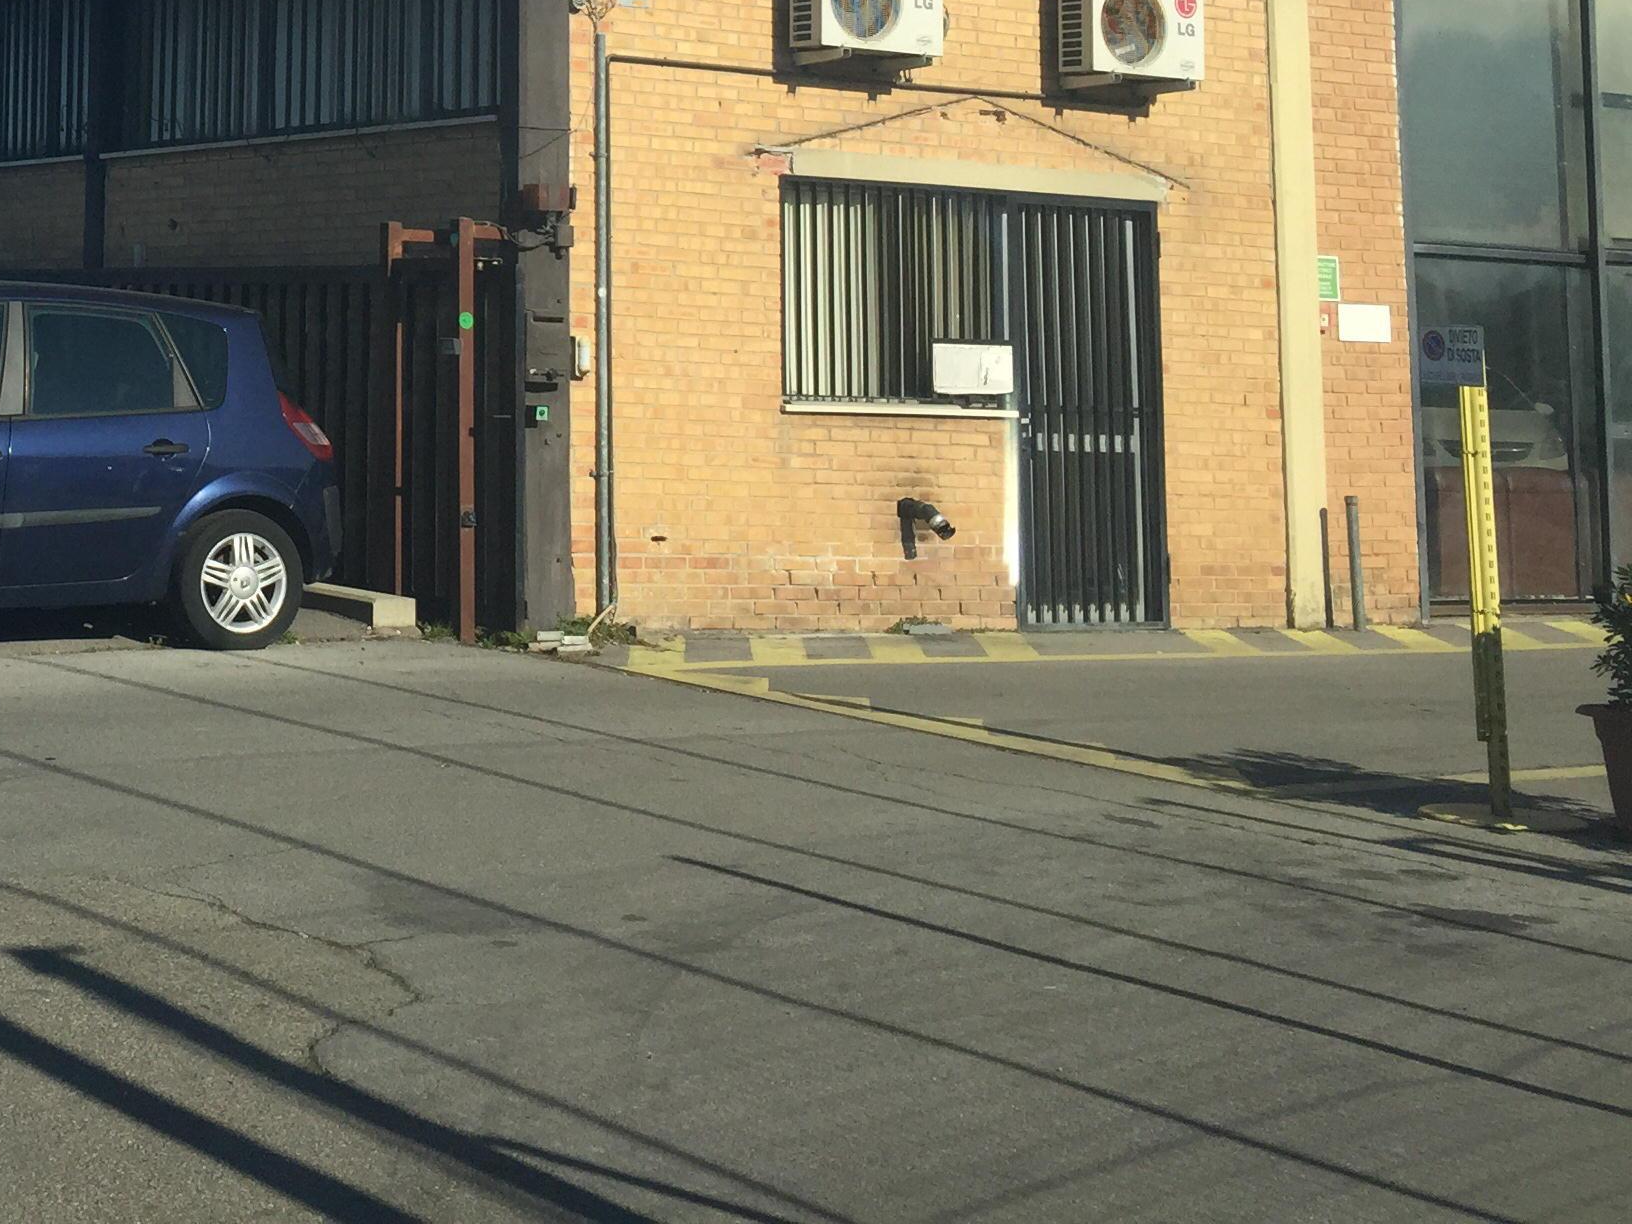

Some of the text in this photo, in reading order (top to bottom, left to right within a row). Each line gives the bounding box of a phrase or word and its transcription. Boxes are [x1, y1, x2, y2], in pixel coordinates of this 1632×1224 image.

[1177, 22, 1196, 37] LG
[1449, 329, 1478, 344] DIVIETO
[1456, 347, 1482, 363] SOSTA
